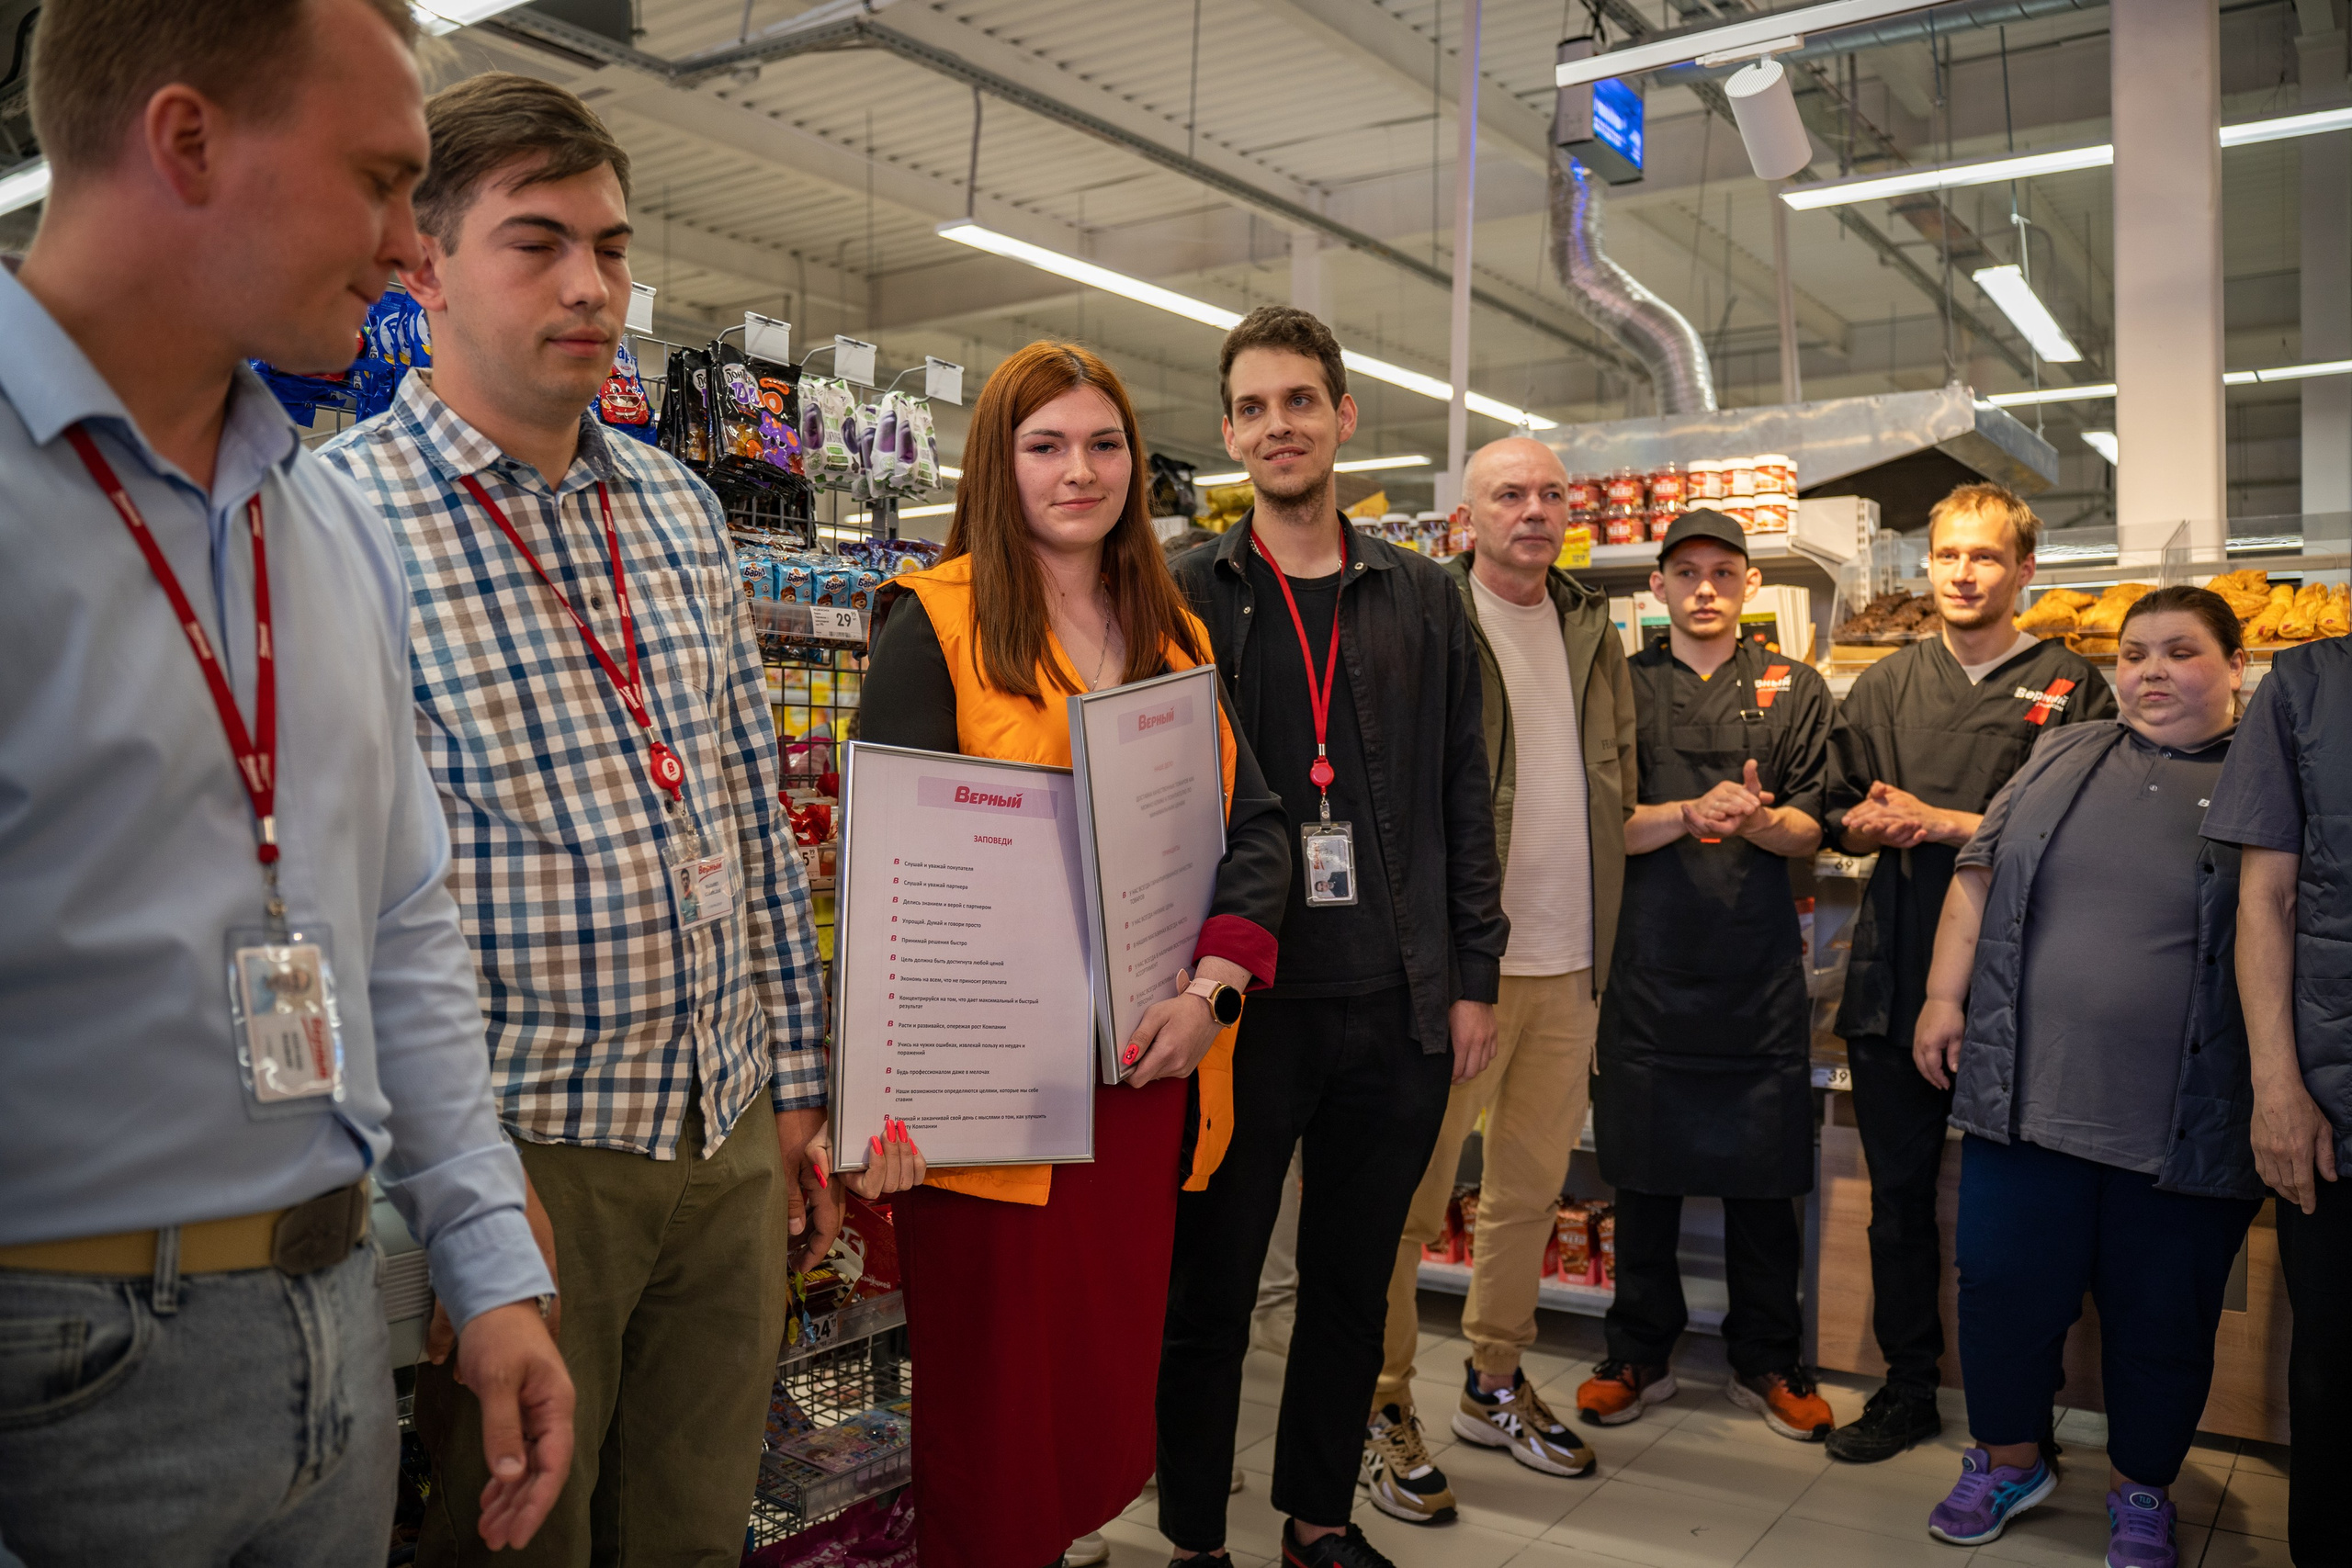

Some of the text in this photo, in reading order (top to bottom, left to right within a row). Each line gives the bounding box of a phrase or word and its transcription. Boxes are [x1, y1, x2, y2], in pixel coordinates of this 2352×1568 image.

[836, 613, 851, 627] 29
[974, 835, 1012, 846] ЗАПОВЕДИ
[698, 859, 722, 874] Верный
[1836, 860, 1853, 871] 69
[899, 995, 939, 1003] Концентрируйся
[1828, 1070, 1848, 1083] 39
